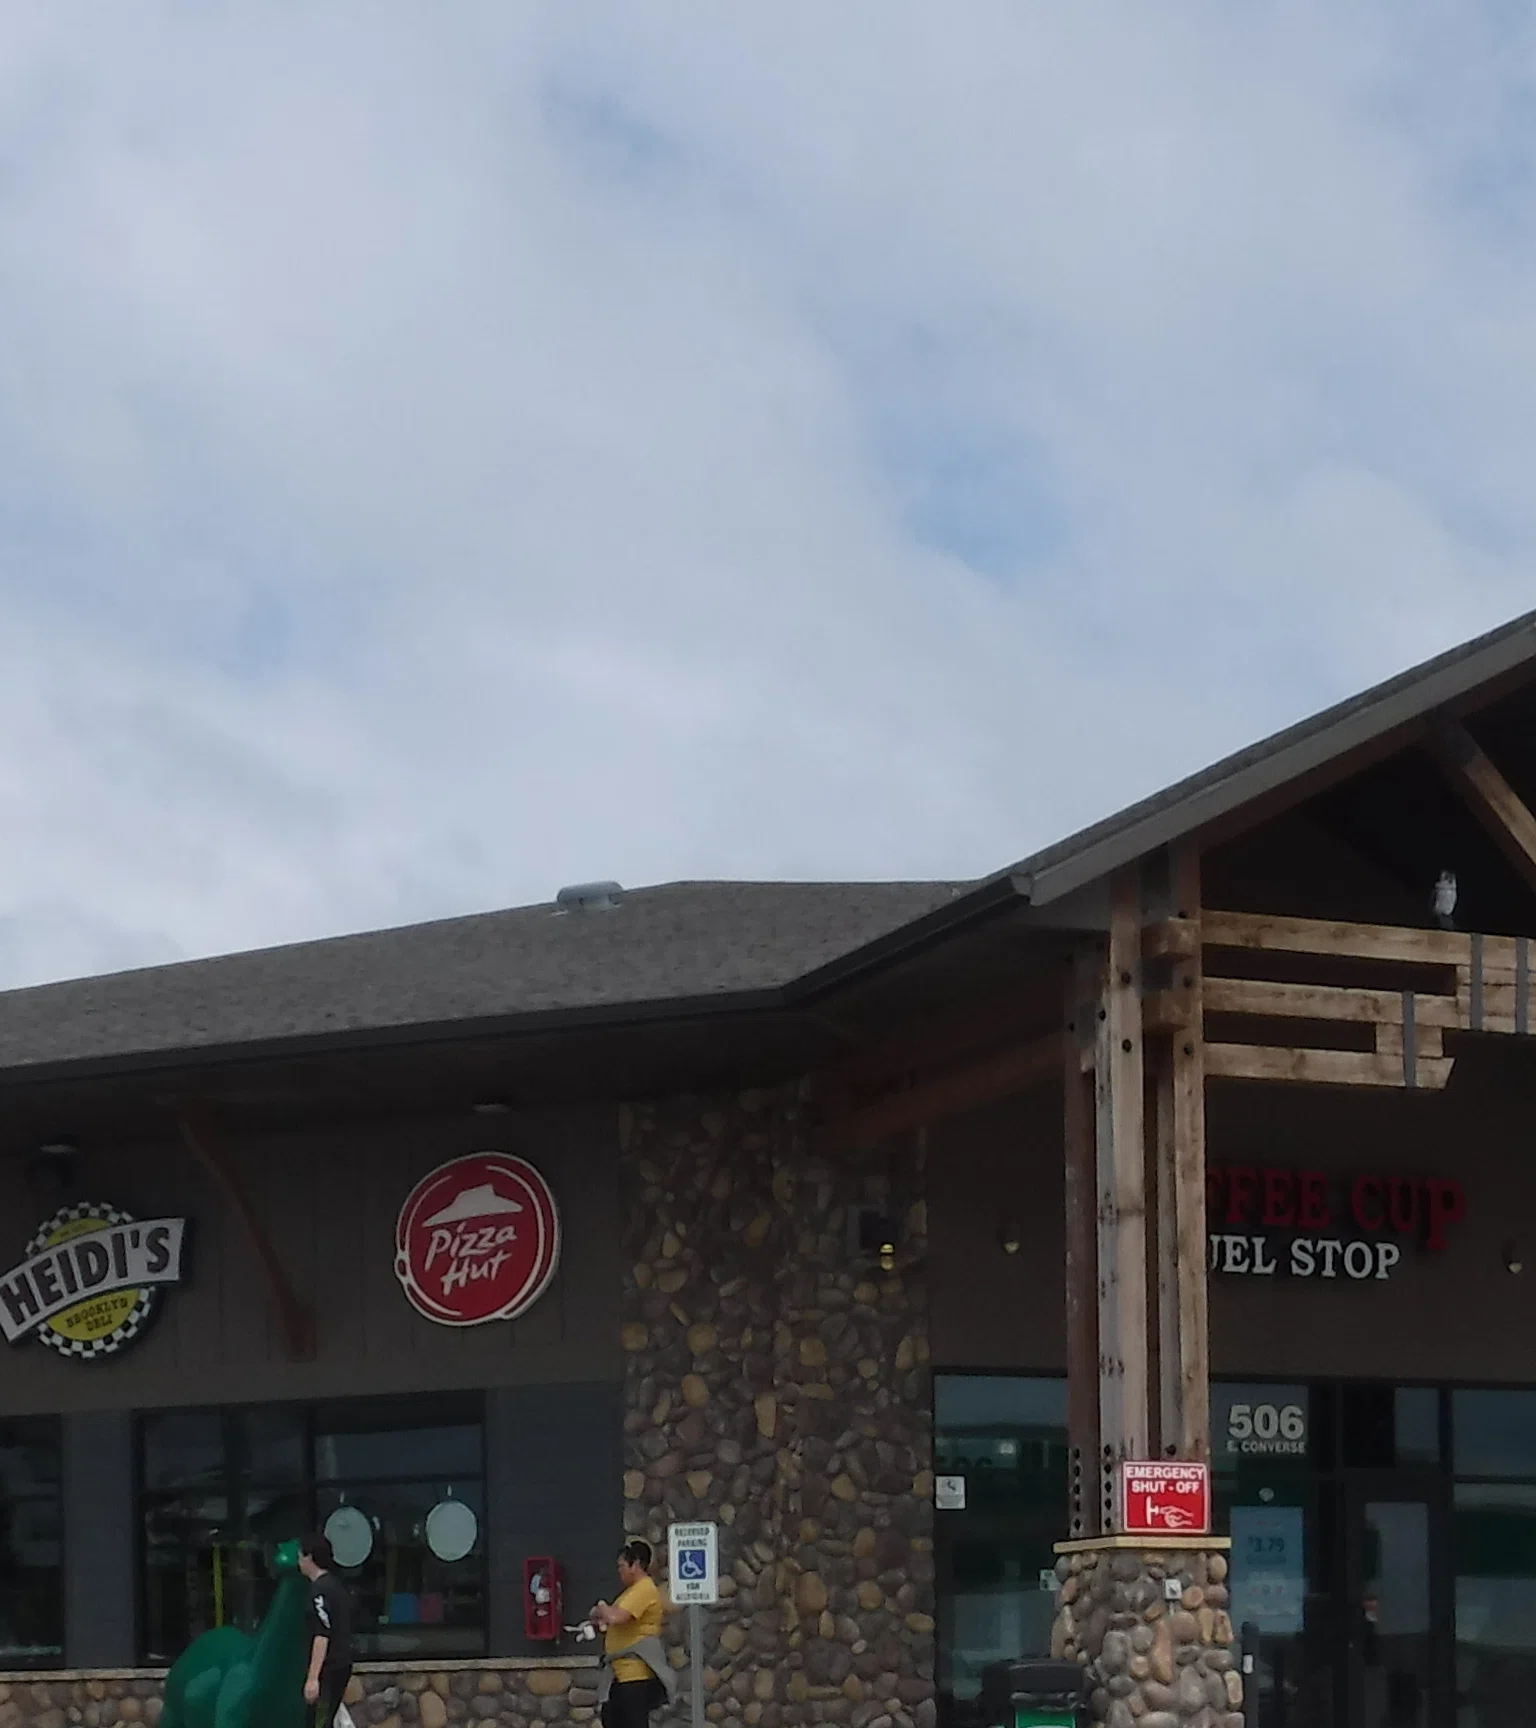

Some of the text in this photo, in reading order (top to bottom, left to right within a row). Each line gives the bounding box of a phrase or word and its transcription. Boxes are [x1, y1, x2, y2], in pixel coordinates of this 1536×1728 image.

[1351, 1173, 1466, 1251] CUP
[422, 1223, 519, 1270] Pizza
[1290, 1237, 1401, 1280] STOP
[440, 1252, 511, 1297] Hut
[86, 1314, 113, 1331] DELI
[1228, 1404, 1305, 1440] 506
[1240, 1439, 1306, 1455] CONVERSE
[1126, 1466, 1204, 1481] EMERGENCY
